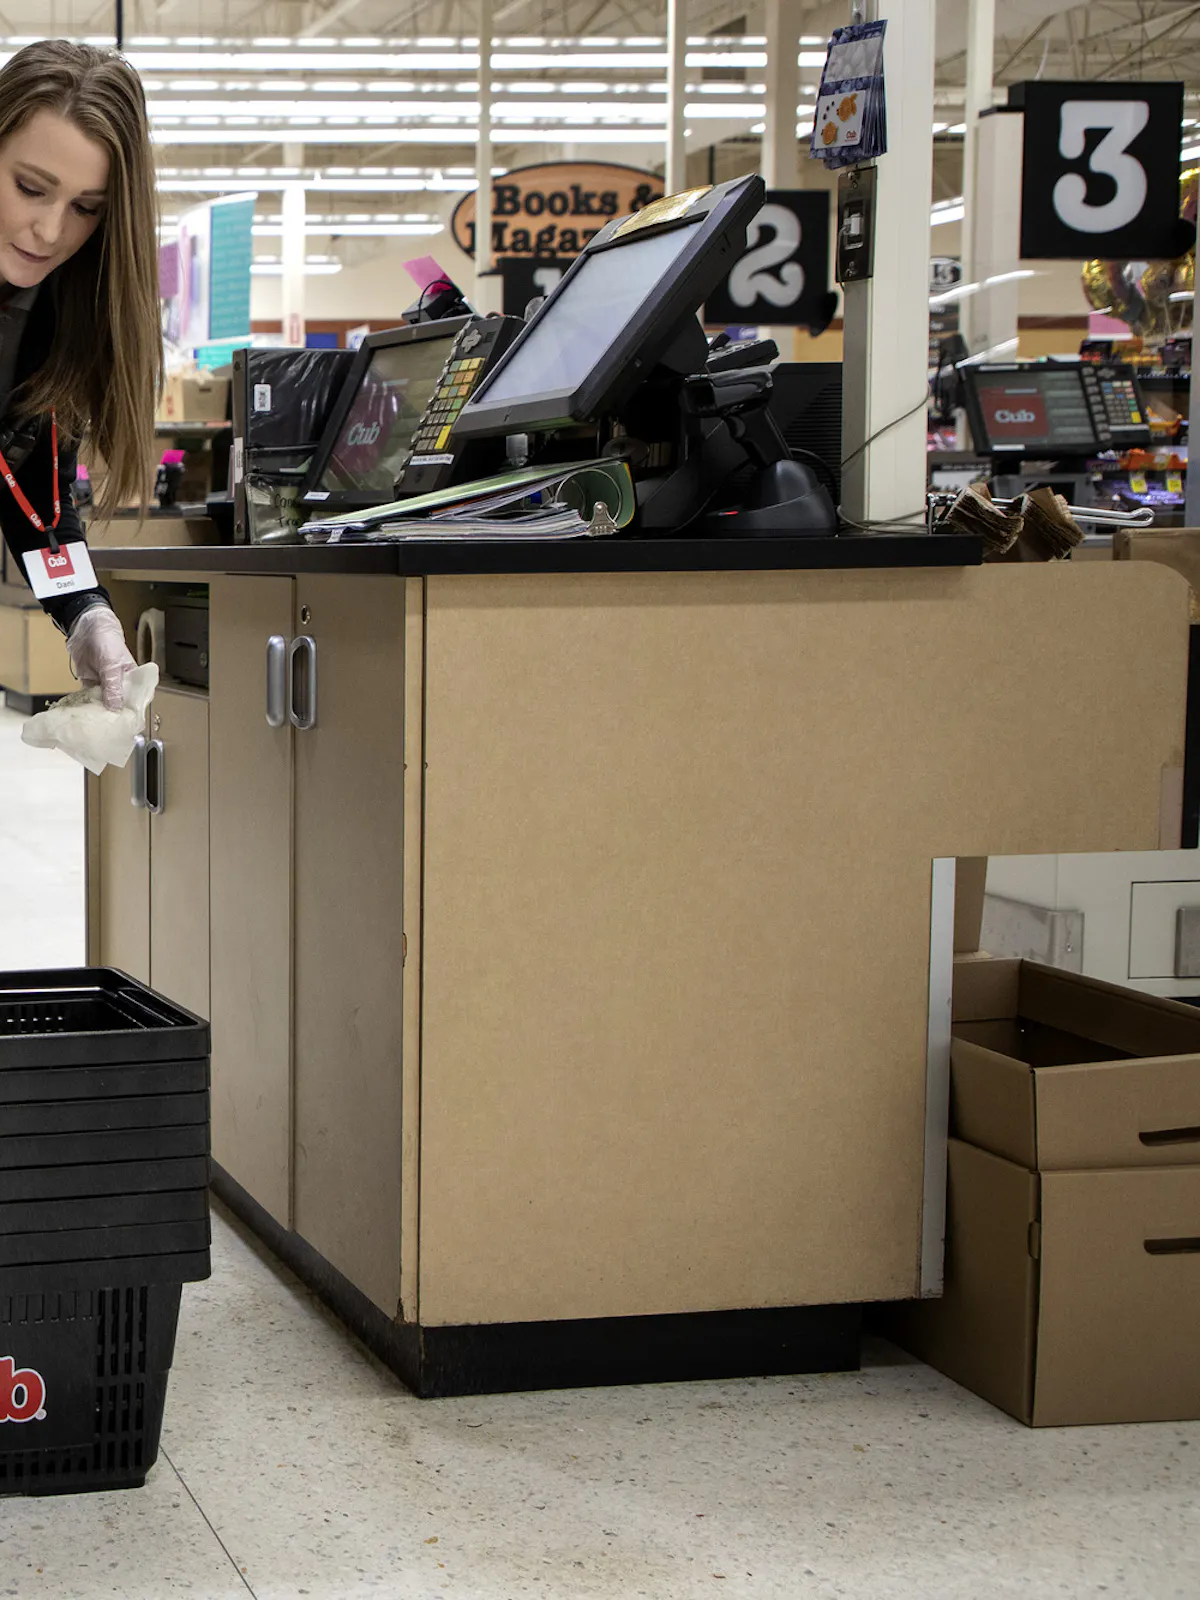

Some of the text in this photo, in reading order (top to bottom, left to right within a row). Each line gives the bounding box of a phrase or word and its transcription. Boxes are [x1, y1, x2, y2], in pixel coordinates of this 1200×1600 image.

[1053, 100, 1150, 234] 3
[492, 184, 618, 216] Books
[465, 221, 611, 259] Magaz
[728, 203, 805, 308] 2
[995, 410, 1035, 423] Cub
[347, 422, 380, 446] Cub
[5, 473, 16, 488] Cub
[30, 513, 41, 527] Cub
[48, 556, 67, 568] Cub
